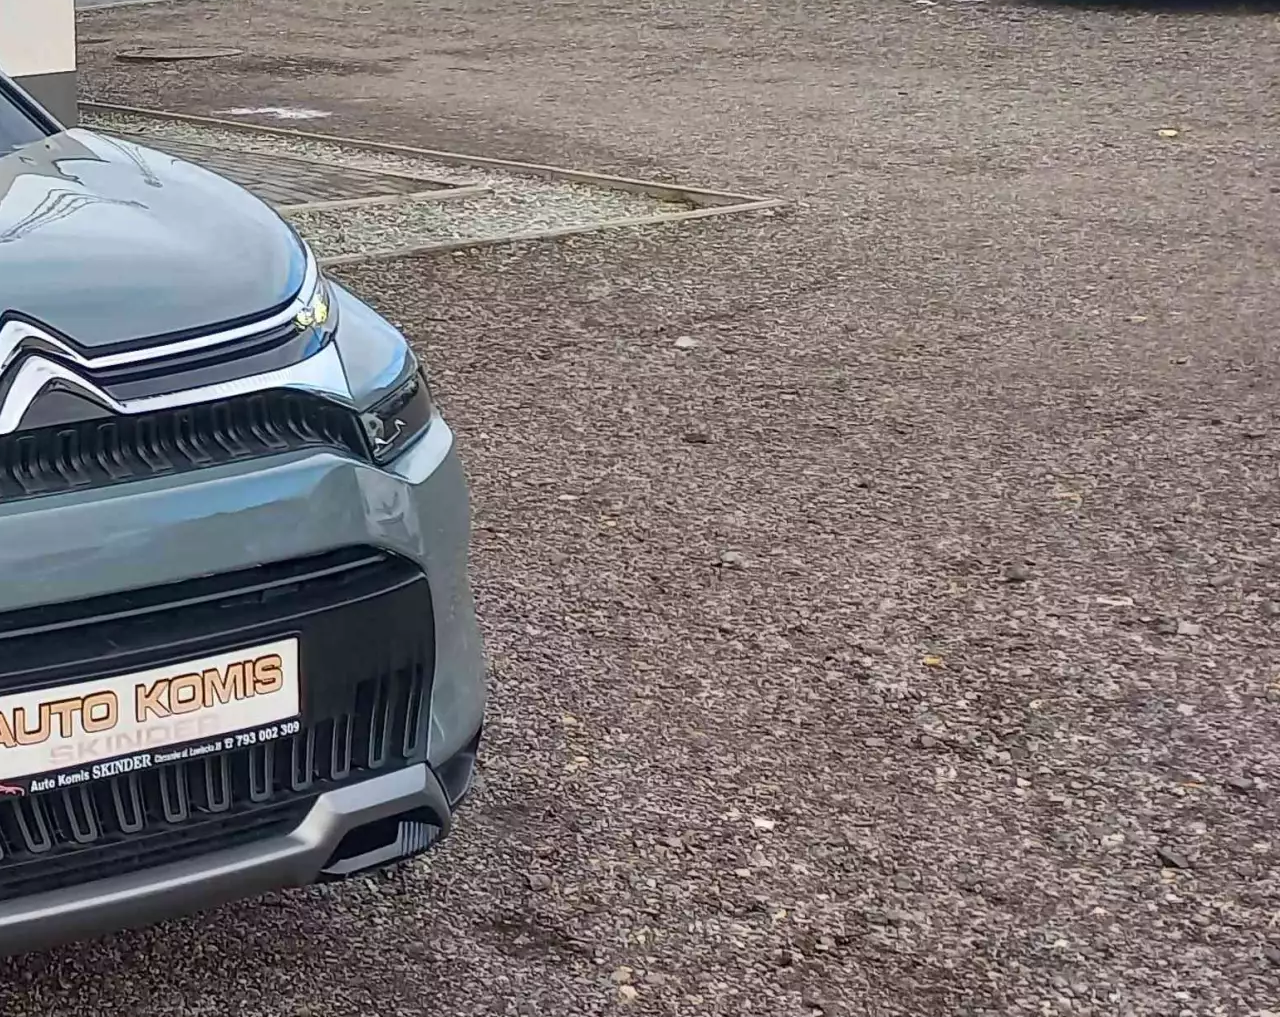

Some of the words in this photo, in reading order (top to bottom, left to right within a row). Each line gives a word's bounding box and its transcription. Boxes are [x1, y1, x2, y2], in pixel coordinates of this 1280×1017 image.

[134, 653, 283, 723] KOMIS
[30, 778, 56, 793] Auto
[58, 770, 90, 787] Komis
[92, 753, 153, 780] SKINDER
[235, 732, 256, 748] 793
[258, 726, 278, 742] 002
[280, 720, 300, 736] 309
[49, 712, 222, 764] SKINDER
